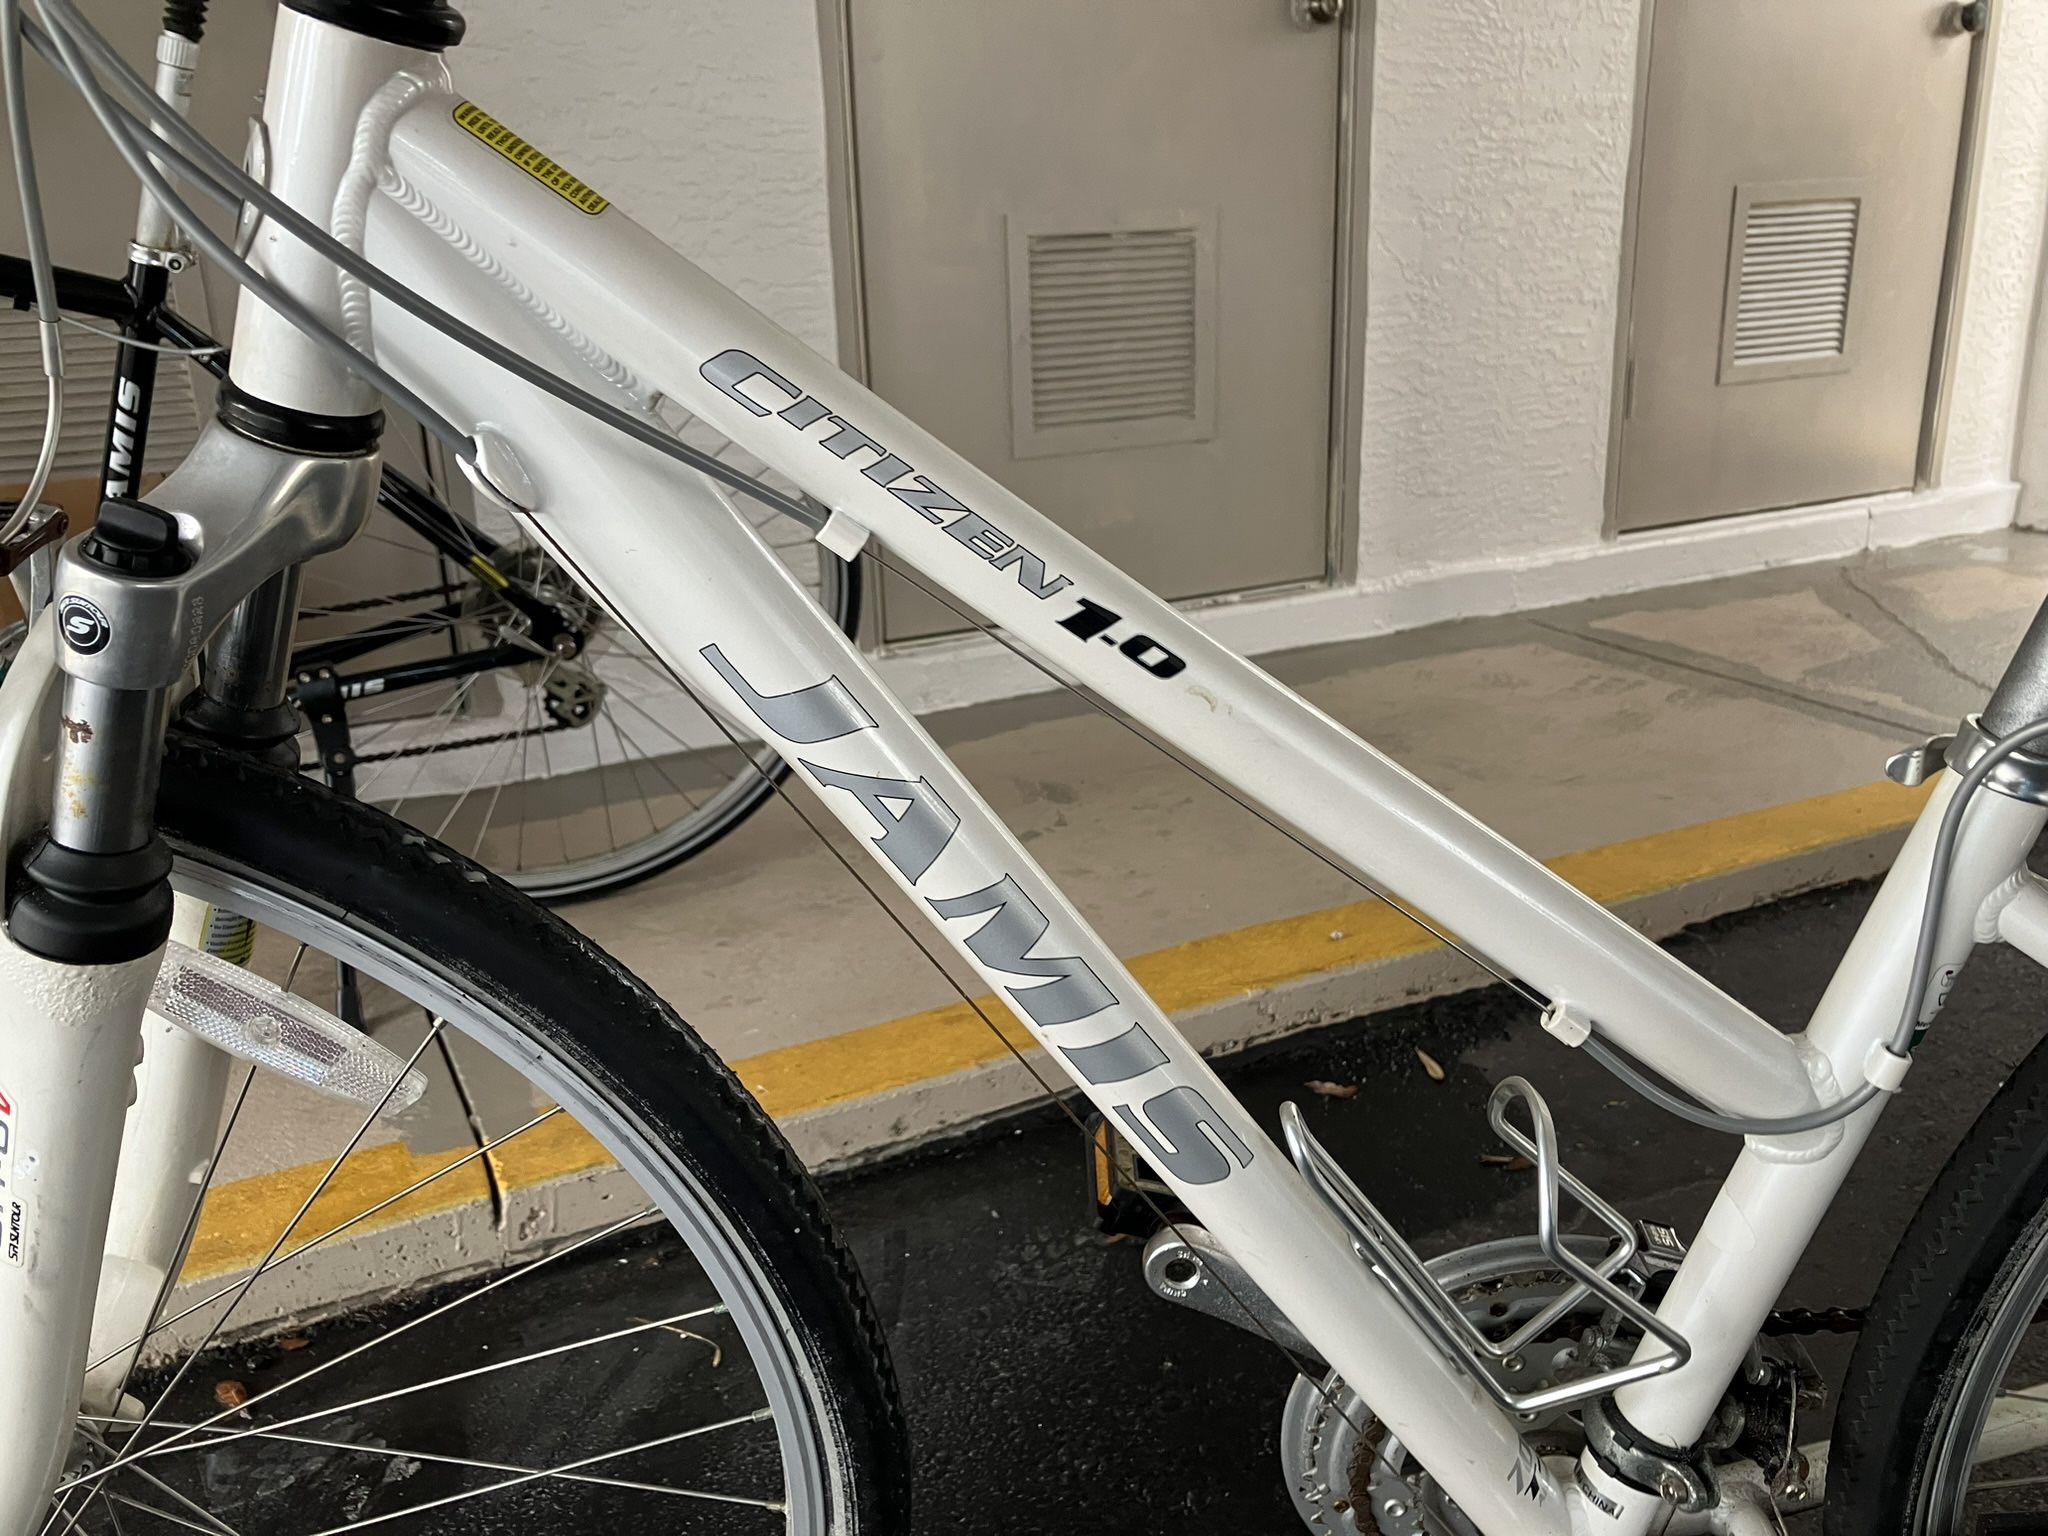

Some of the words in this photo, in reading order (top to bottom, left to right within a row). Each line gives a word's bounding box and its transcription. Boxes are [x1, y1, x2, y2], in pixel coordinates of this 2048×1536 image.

[700, 349, 1074, 600] CITIZEN
[699, 643, 1254, 1185] JAMIS
[1582, 1483, 1616, 1517] CHINA
